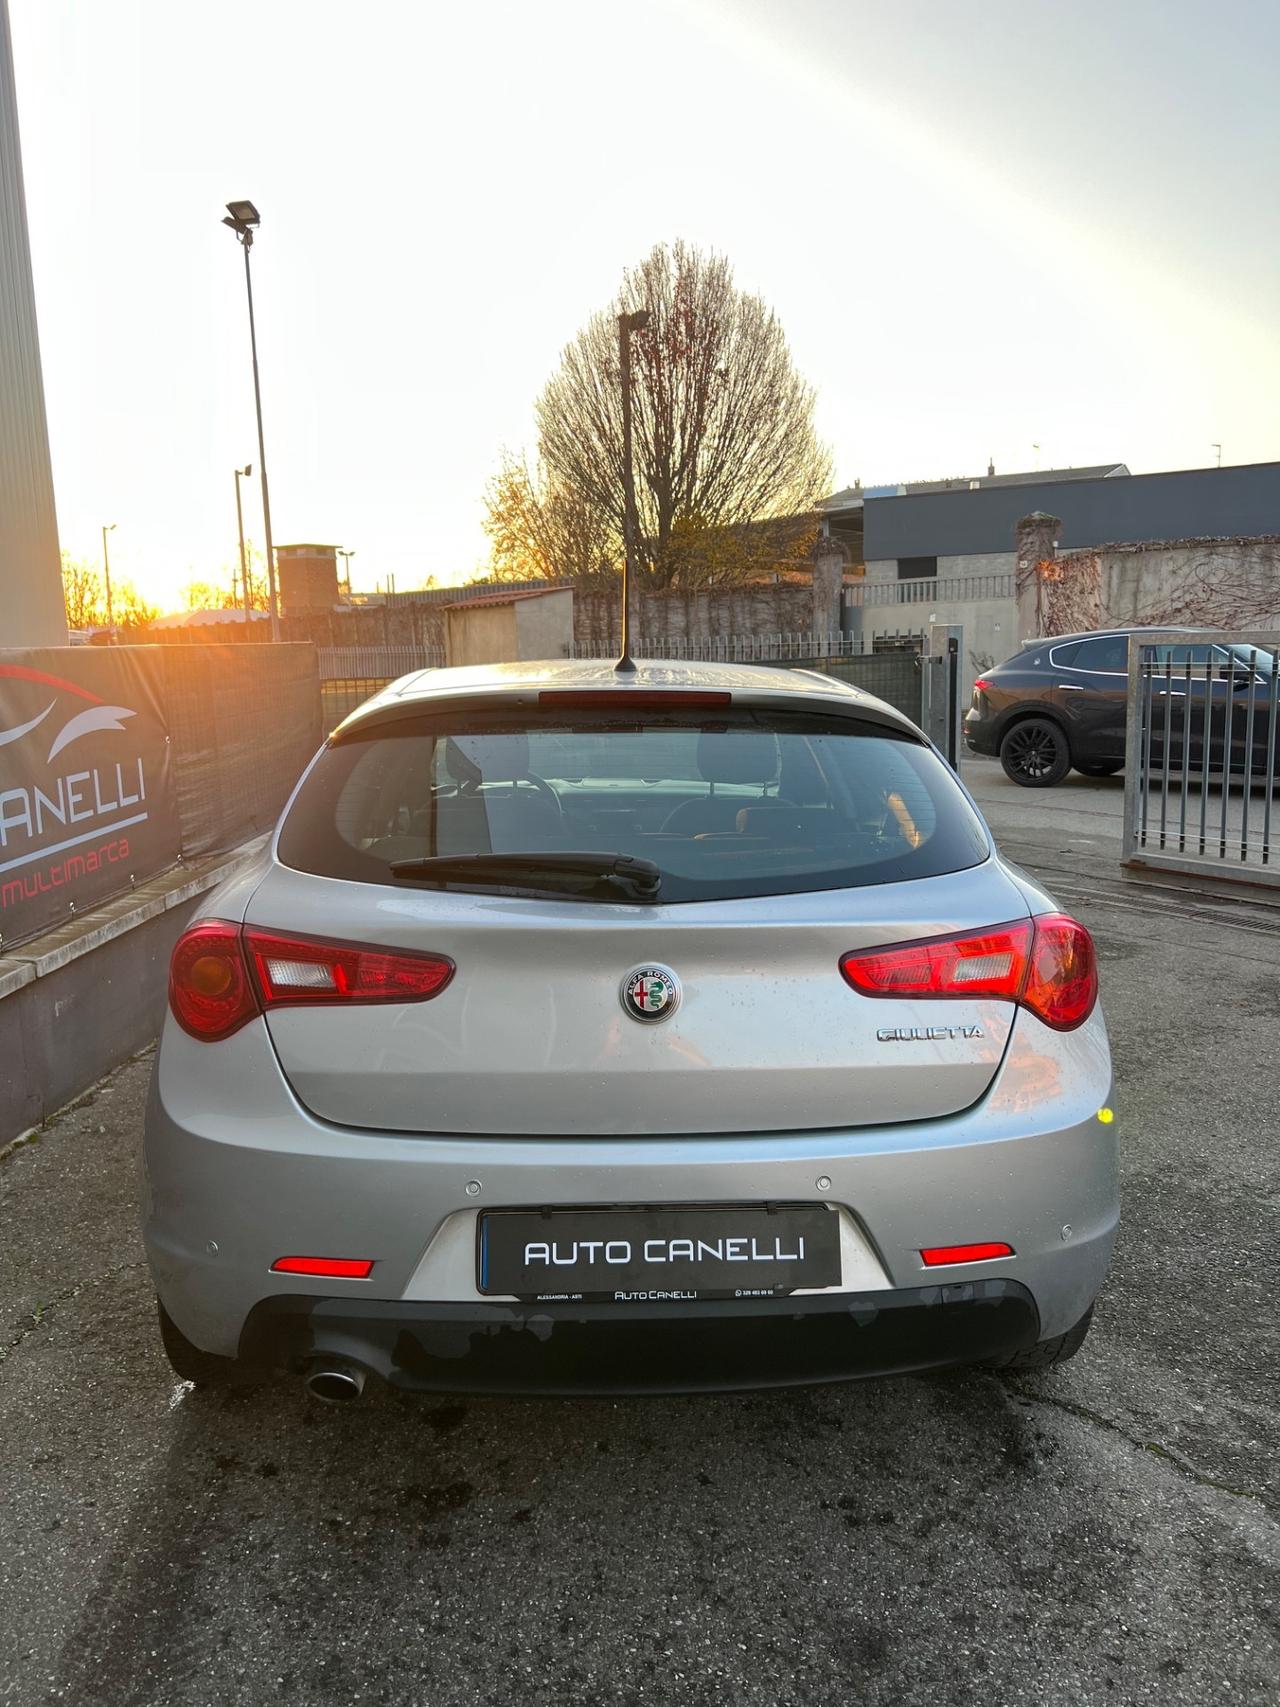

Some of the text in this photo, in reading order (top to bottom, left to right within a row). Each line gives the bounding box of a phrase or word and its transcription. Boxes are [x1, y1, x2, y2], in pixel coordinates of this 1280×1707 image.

[627, 971, 674, 995] ALFA ROMEO
[876, 1025, 985, 1042] GIULIETTA
[524, 1236, 805, 1266] AUTO CANELLI
